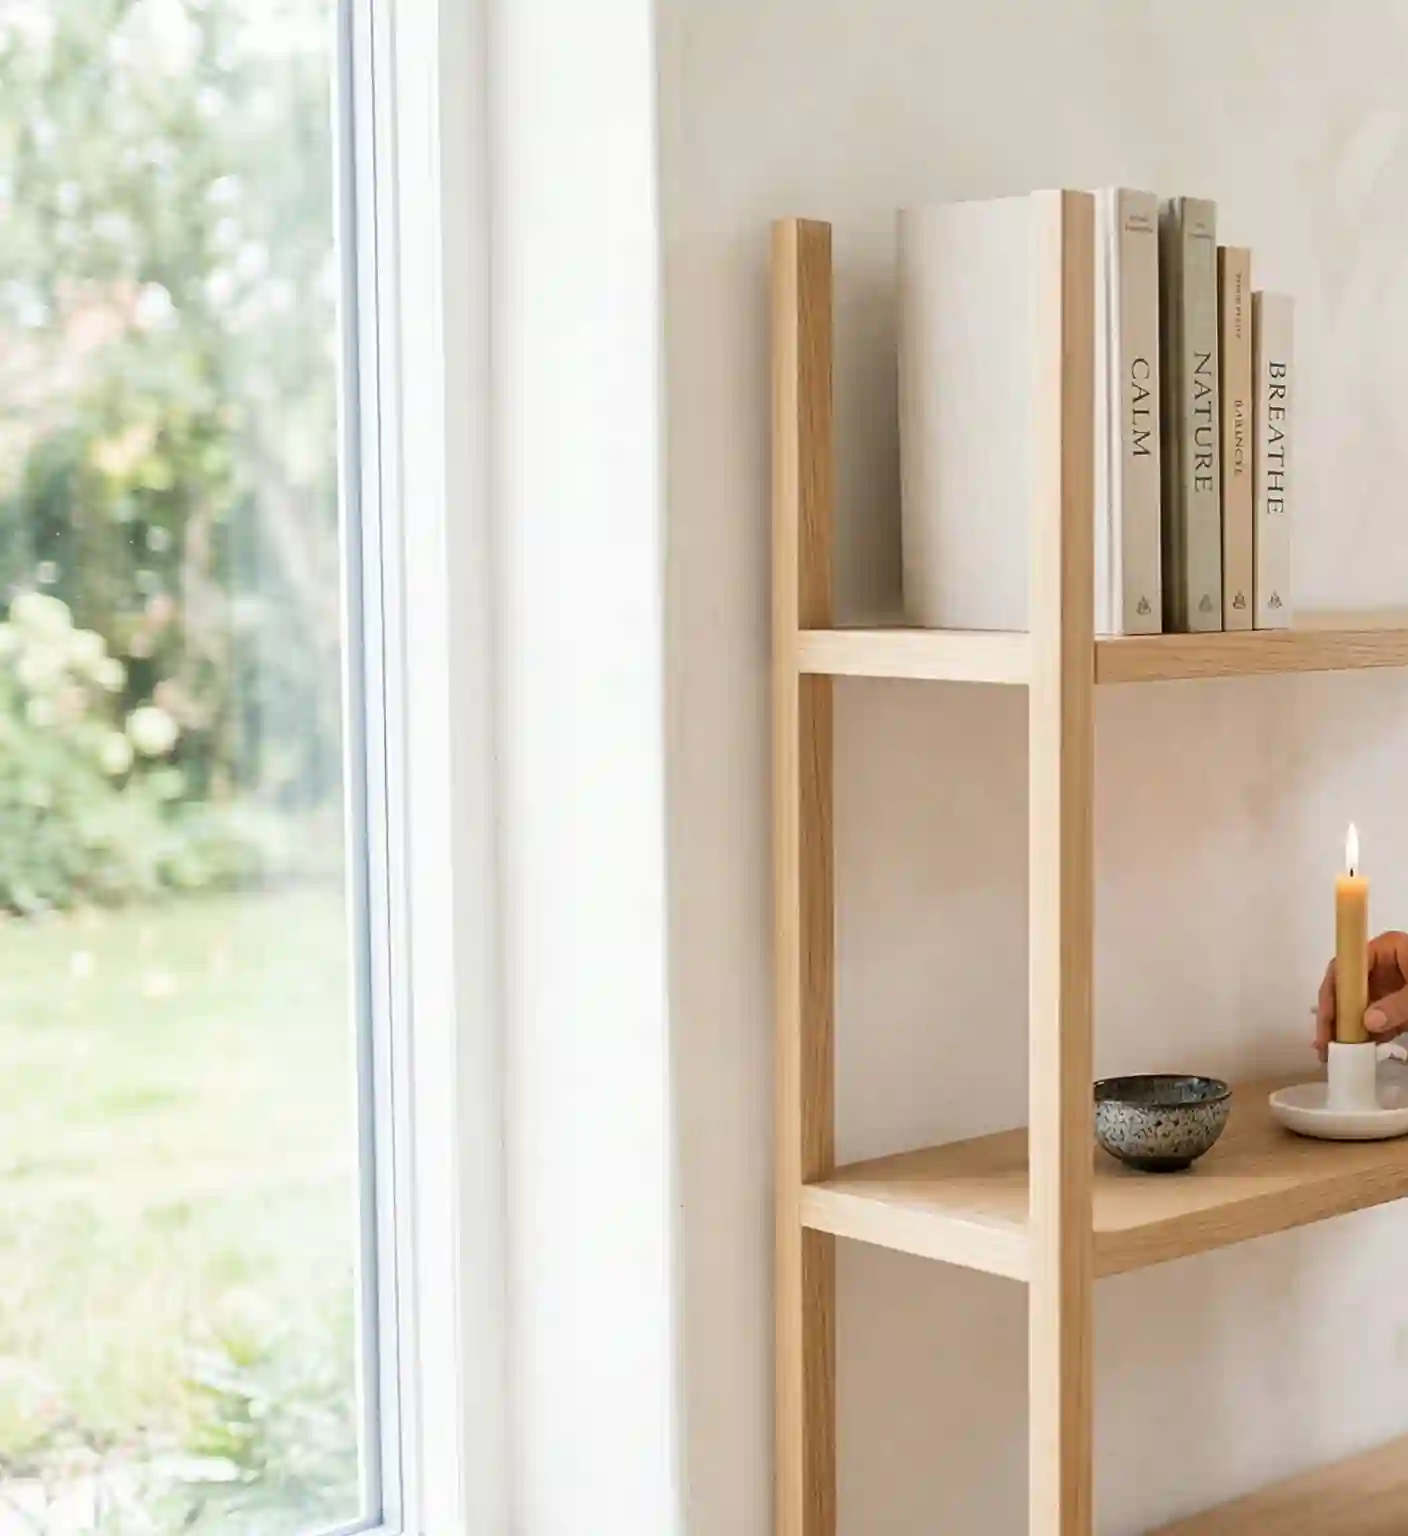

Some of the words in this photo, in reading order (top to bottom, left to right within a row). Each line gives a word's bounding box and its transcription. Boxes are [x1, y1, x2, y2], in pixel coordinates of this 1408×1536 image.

[1131, 358, 1151, 457] CALM
[1194, 351, 1214, 493] NATURE
[1267, 361, 1286, 515] BREATHE
